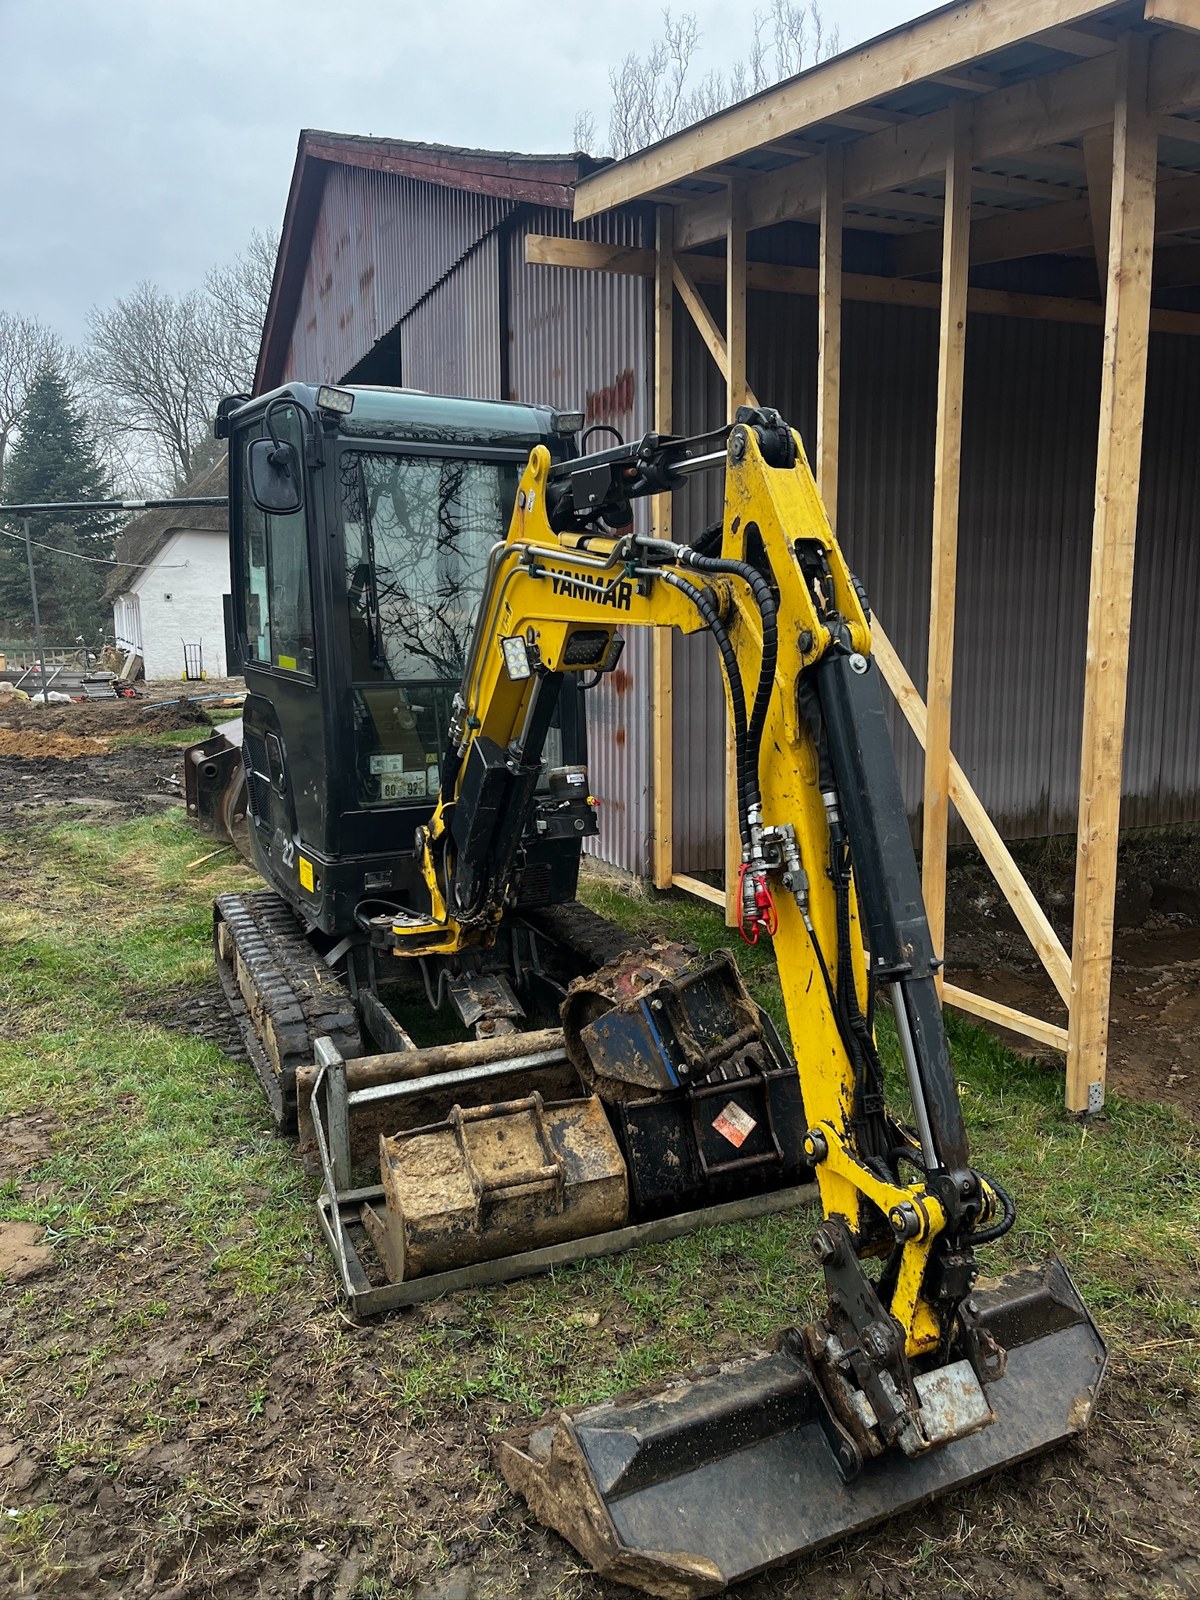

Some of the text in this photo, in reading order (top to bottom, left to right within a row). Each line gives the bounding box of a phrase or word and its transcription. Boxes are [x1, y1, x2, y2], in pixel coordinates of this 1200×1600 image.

[551, 568, 632, 611] YANMAR
[385, 782, 418, 796] 80 92
